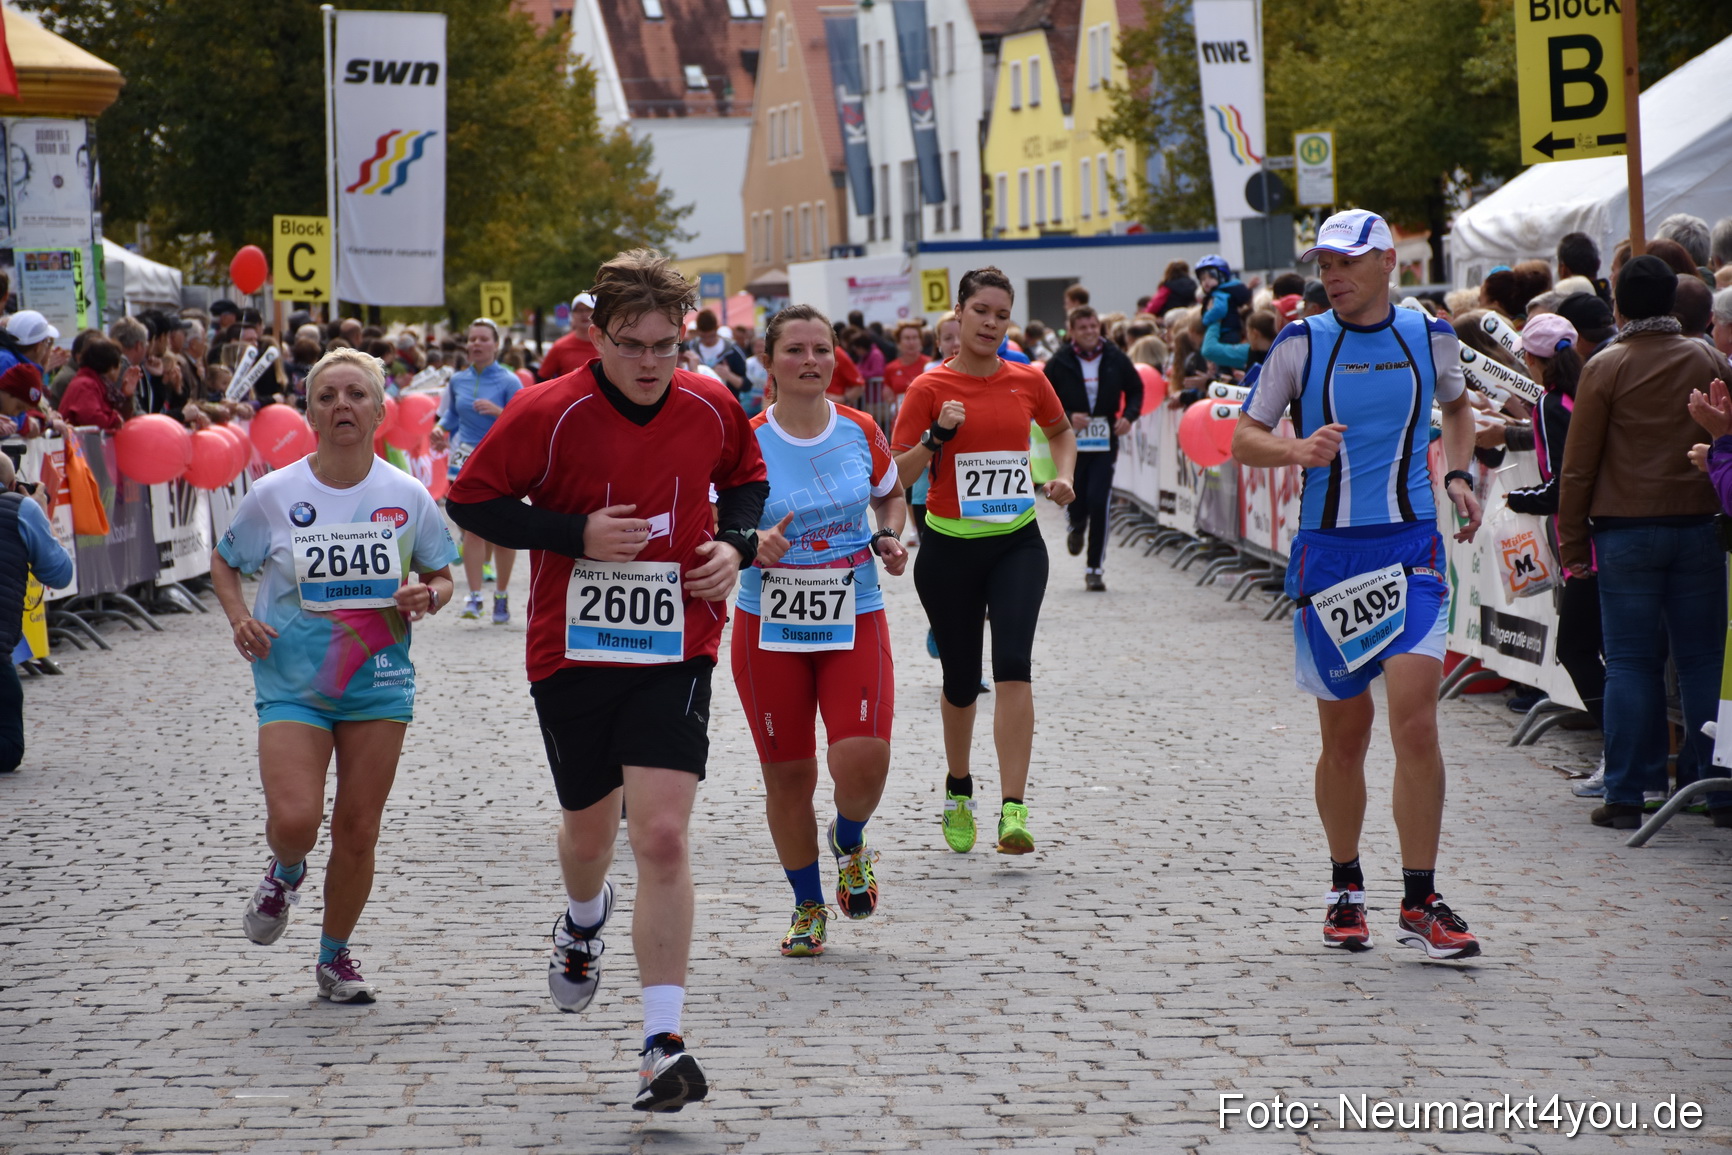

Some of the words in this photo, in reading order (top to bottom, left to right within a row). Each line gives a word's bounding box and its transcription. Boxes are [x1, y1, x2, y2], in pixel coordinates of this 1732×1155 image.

[1530, 0, 1621, 21] Block
[344, 58, 439, 86] swn
[1548, 34, 1608, 122] B
[280, 219, 324, 236] Block
[287, 241, 316, 283] C
[928, 281, 945, 303] D
[489, 296, 505, 317] D
[957, 459, 984, 467] PARTL
[986, 458, 1019, 466] Neumarkt
[965, 469, 1028, 497] 2772
[982, 502, 1017, 513] Sandra
[294, 534, 329, 544] PARTL
[331, 531, 378, 541] Neumarkt
[1501, 531, 1534, 550] Müller
[306, 543, 390, 579] 2646
[1514, 554, 1536, 577] M
[573, 568, 610, 581] PARTL
[612, 571, 664, 582] Neumarkt
[794, 578, 838, 586] Neumarkt
[326, 583, 372, 598] Izabela
[1316, 592, 1346, 611] PARTL
[1345, 574, 1388, 597] Neumarkt
[579, 585, 675, 626] 2606
[770, 589, 846, 621] 2457
[1331, 581, 1401, 638] 2495
[597, 632, 653, 650] Manuel
[782, 628, 833, 641] Susanne
[1360, 621, 1393, 651] Michael
[374, 654, 392, 669] 16.
[860, 700, 868, 721] FUSION
[764, 713, 775, 736] FUSION
